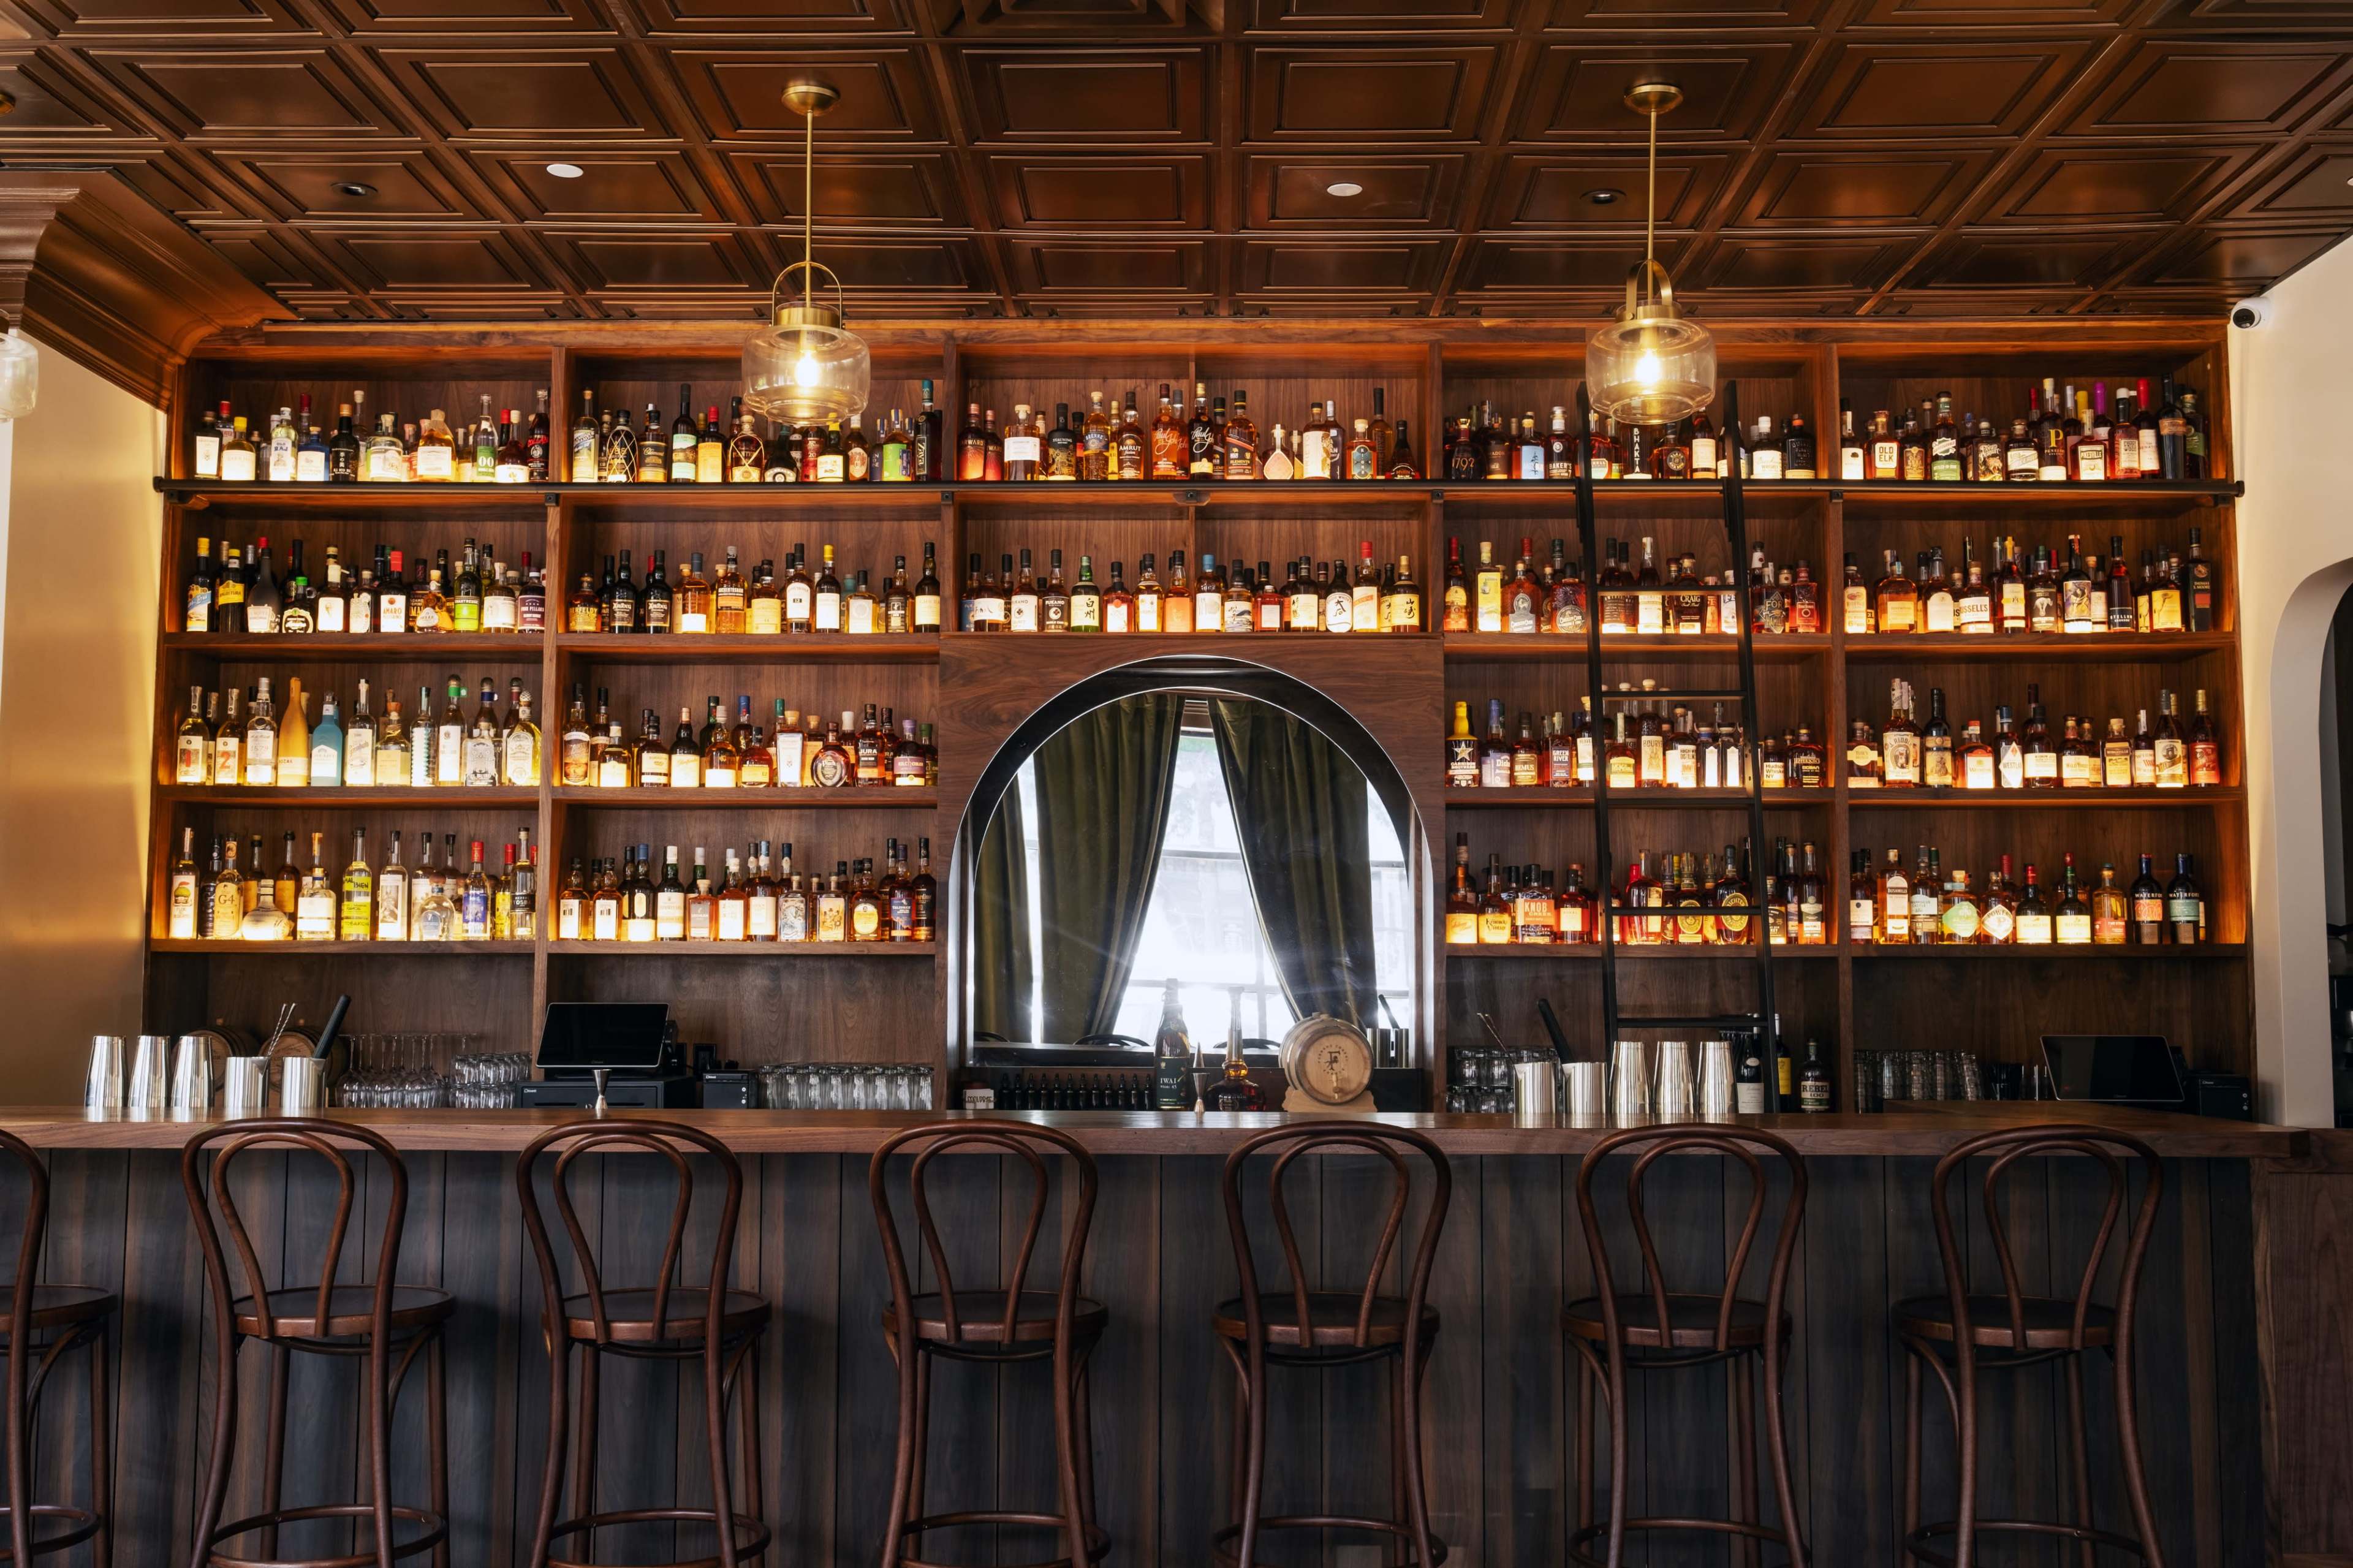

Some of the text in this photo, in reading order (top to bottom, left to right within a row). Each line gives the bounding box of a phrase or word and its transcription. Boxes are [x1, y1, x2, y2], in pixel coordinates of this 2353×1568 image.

[2049, 429, 2063, 447] P
[479, 456, 494, 467] 00
[1452, 458, 1475, 471] 1792
[1085, 598, 1096, 621] 白州
[1403, 598, 1417, 619] 山崎
[1765, 600, 1783, 608] FOR
[220, 751, 230, 770] 2
[218, 894, 236, 904] G4
[1525, 902, 1547, 912] KNOB
[1802, 1084, 1829, 1093] REBEL
